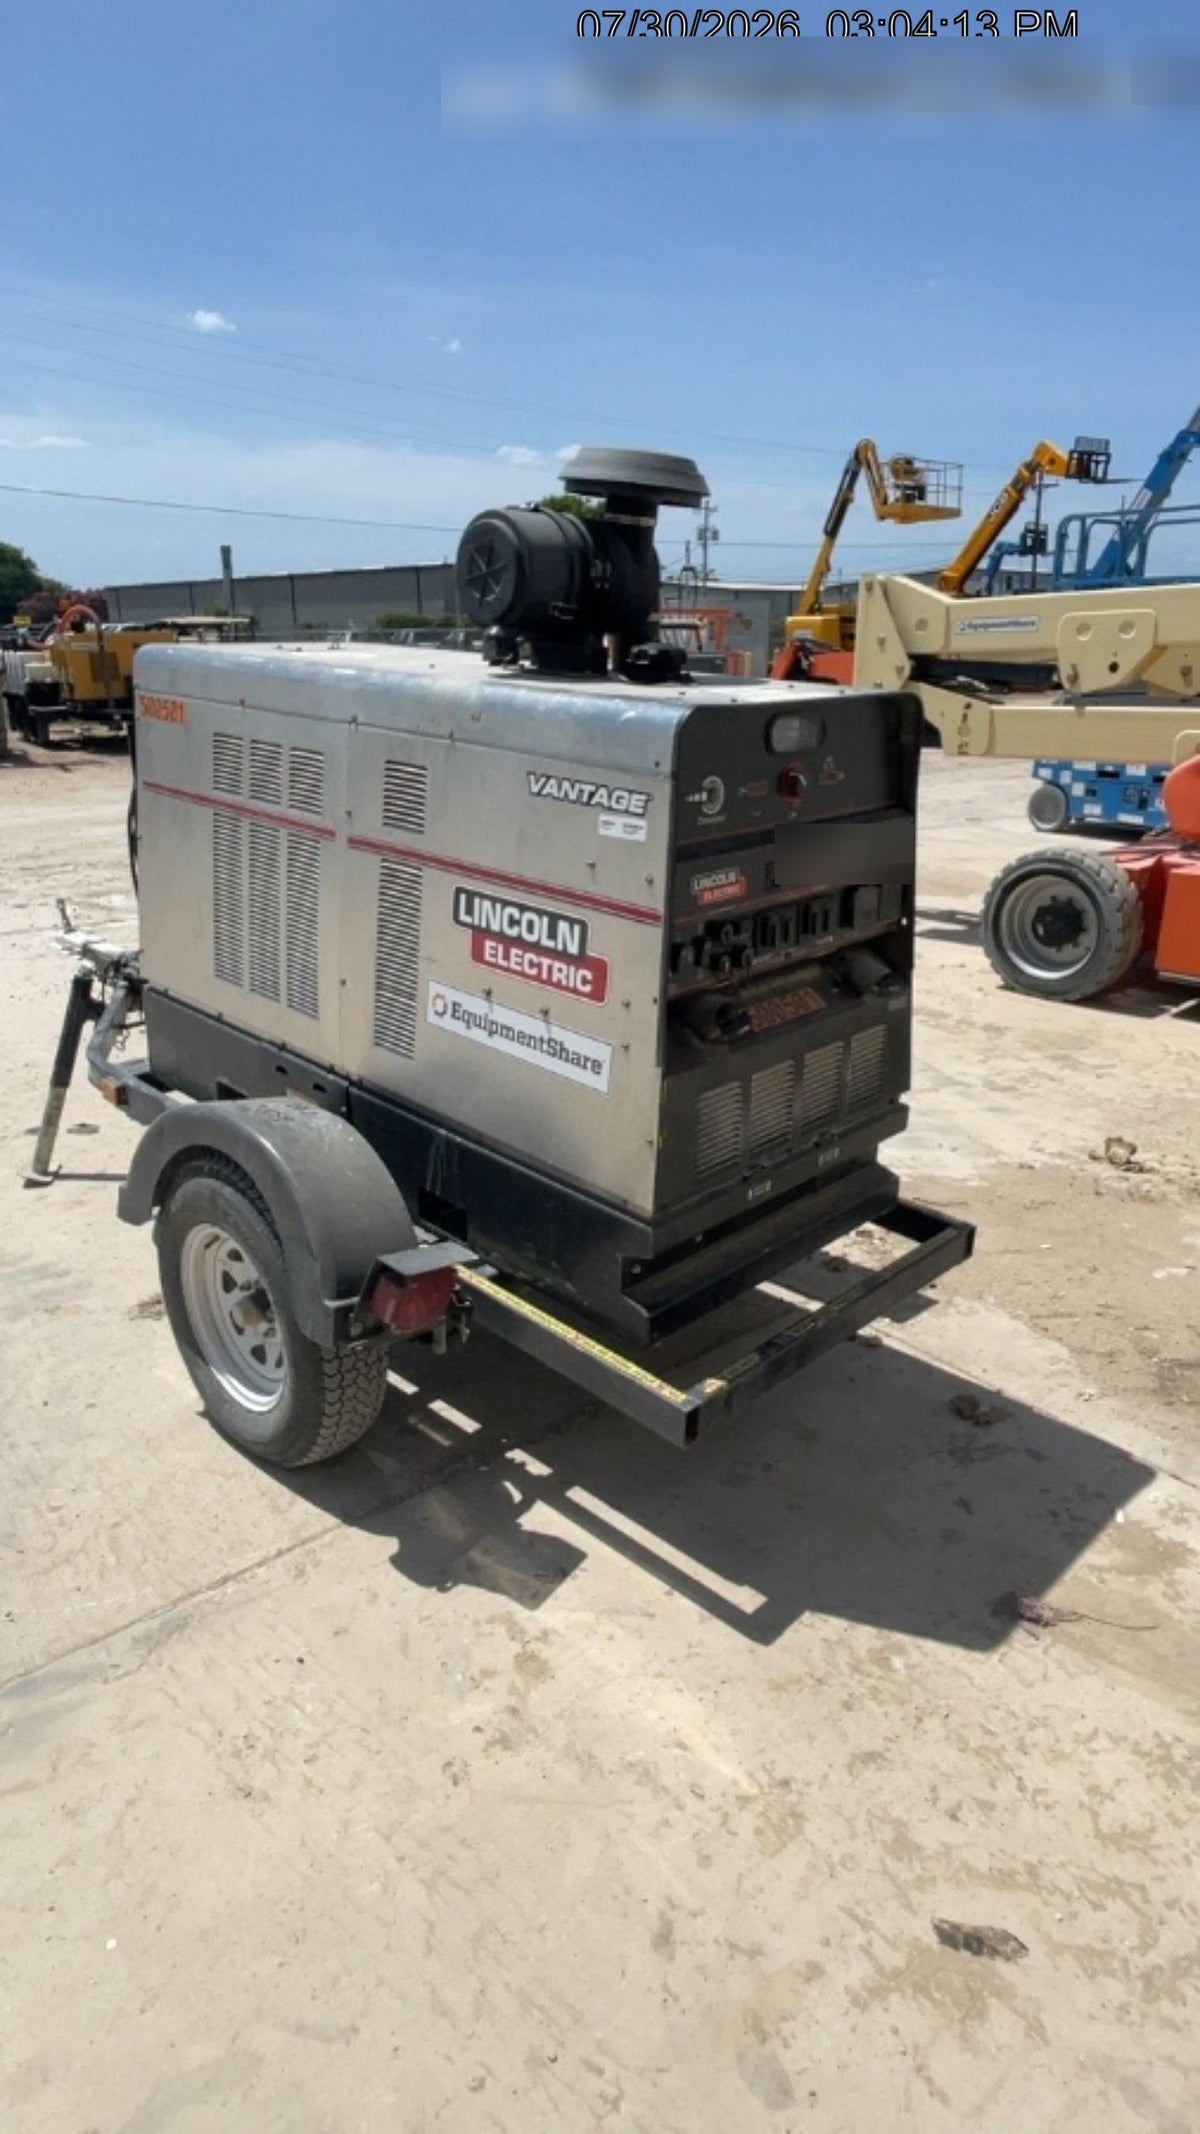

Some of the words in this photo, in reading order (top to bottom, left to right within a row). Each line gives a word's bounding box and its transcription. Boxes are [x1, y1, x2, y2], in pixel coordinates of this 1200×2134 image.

[527, 771, 648, 817] VANTAGE
[458, 892, 581, 956] LINCOLN
[484, 940, 593, 993] ELECTRIC
[450, 1002, 604, 1076] EquipmentShare
